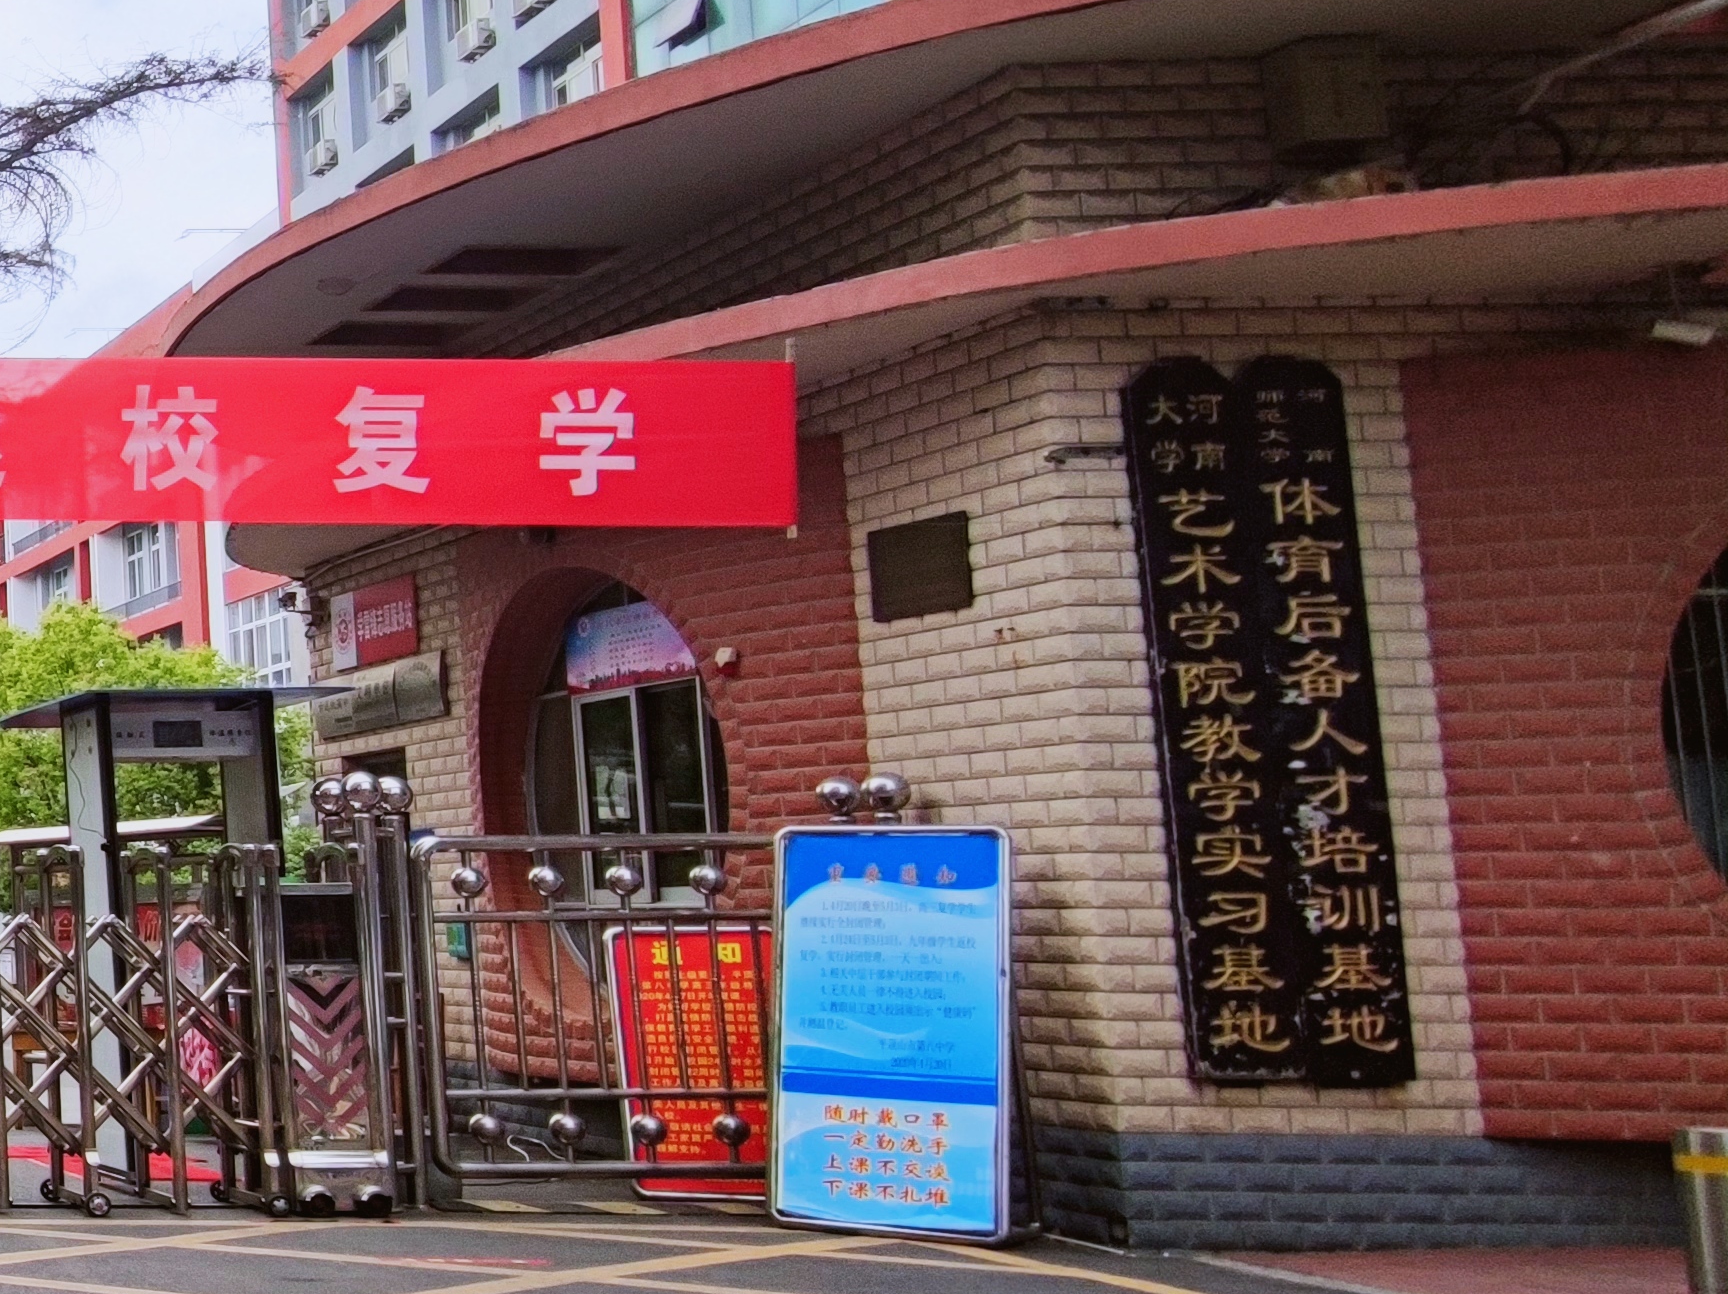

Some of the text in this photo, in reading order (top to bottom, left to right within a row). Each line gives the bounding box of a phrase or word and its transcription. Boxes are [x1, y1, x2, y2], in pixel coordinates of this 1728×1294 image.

[1158, 489, 1292, 1053] 艺术学院教学实习基地
[1260, 477, 1399, 1056] 体育后备人才培训基地
[824, 1103, 950, 1132] 随时戴口罩
[823, 1129, 949, 1156] 一定勤洗手
[822, 1154, 950, 1182] 上课不交谈
[822, 1179, 950, 1208] 下课不扎堆
